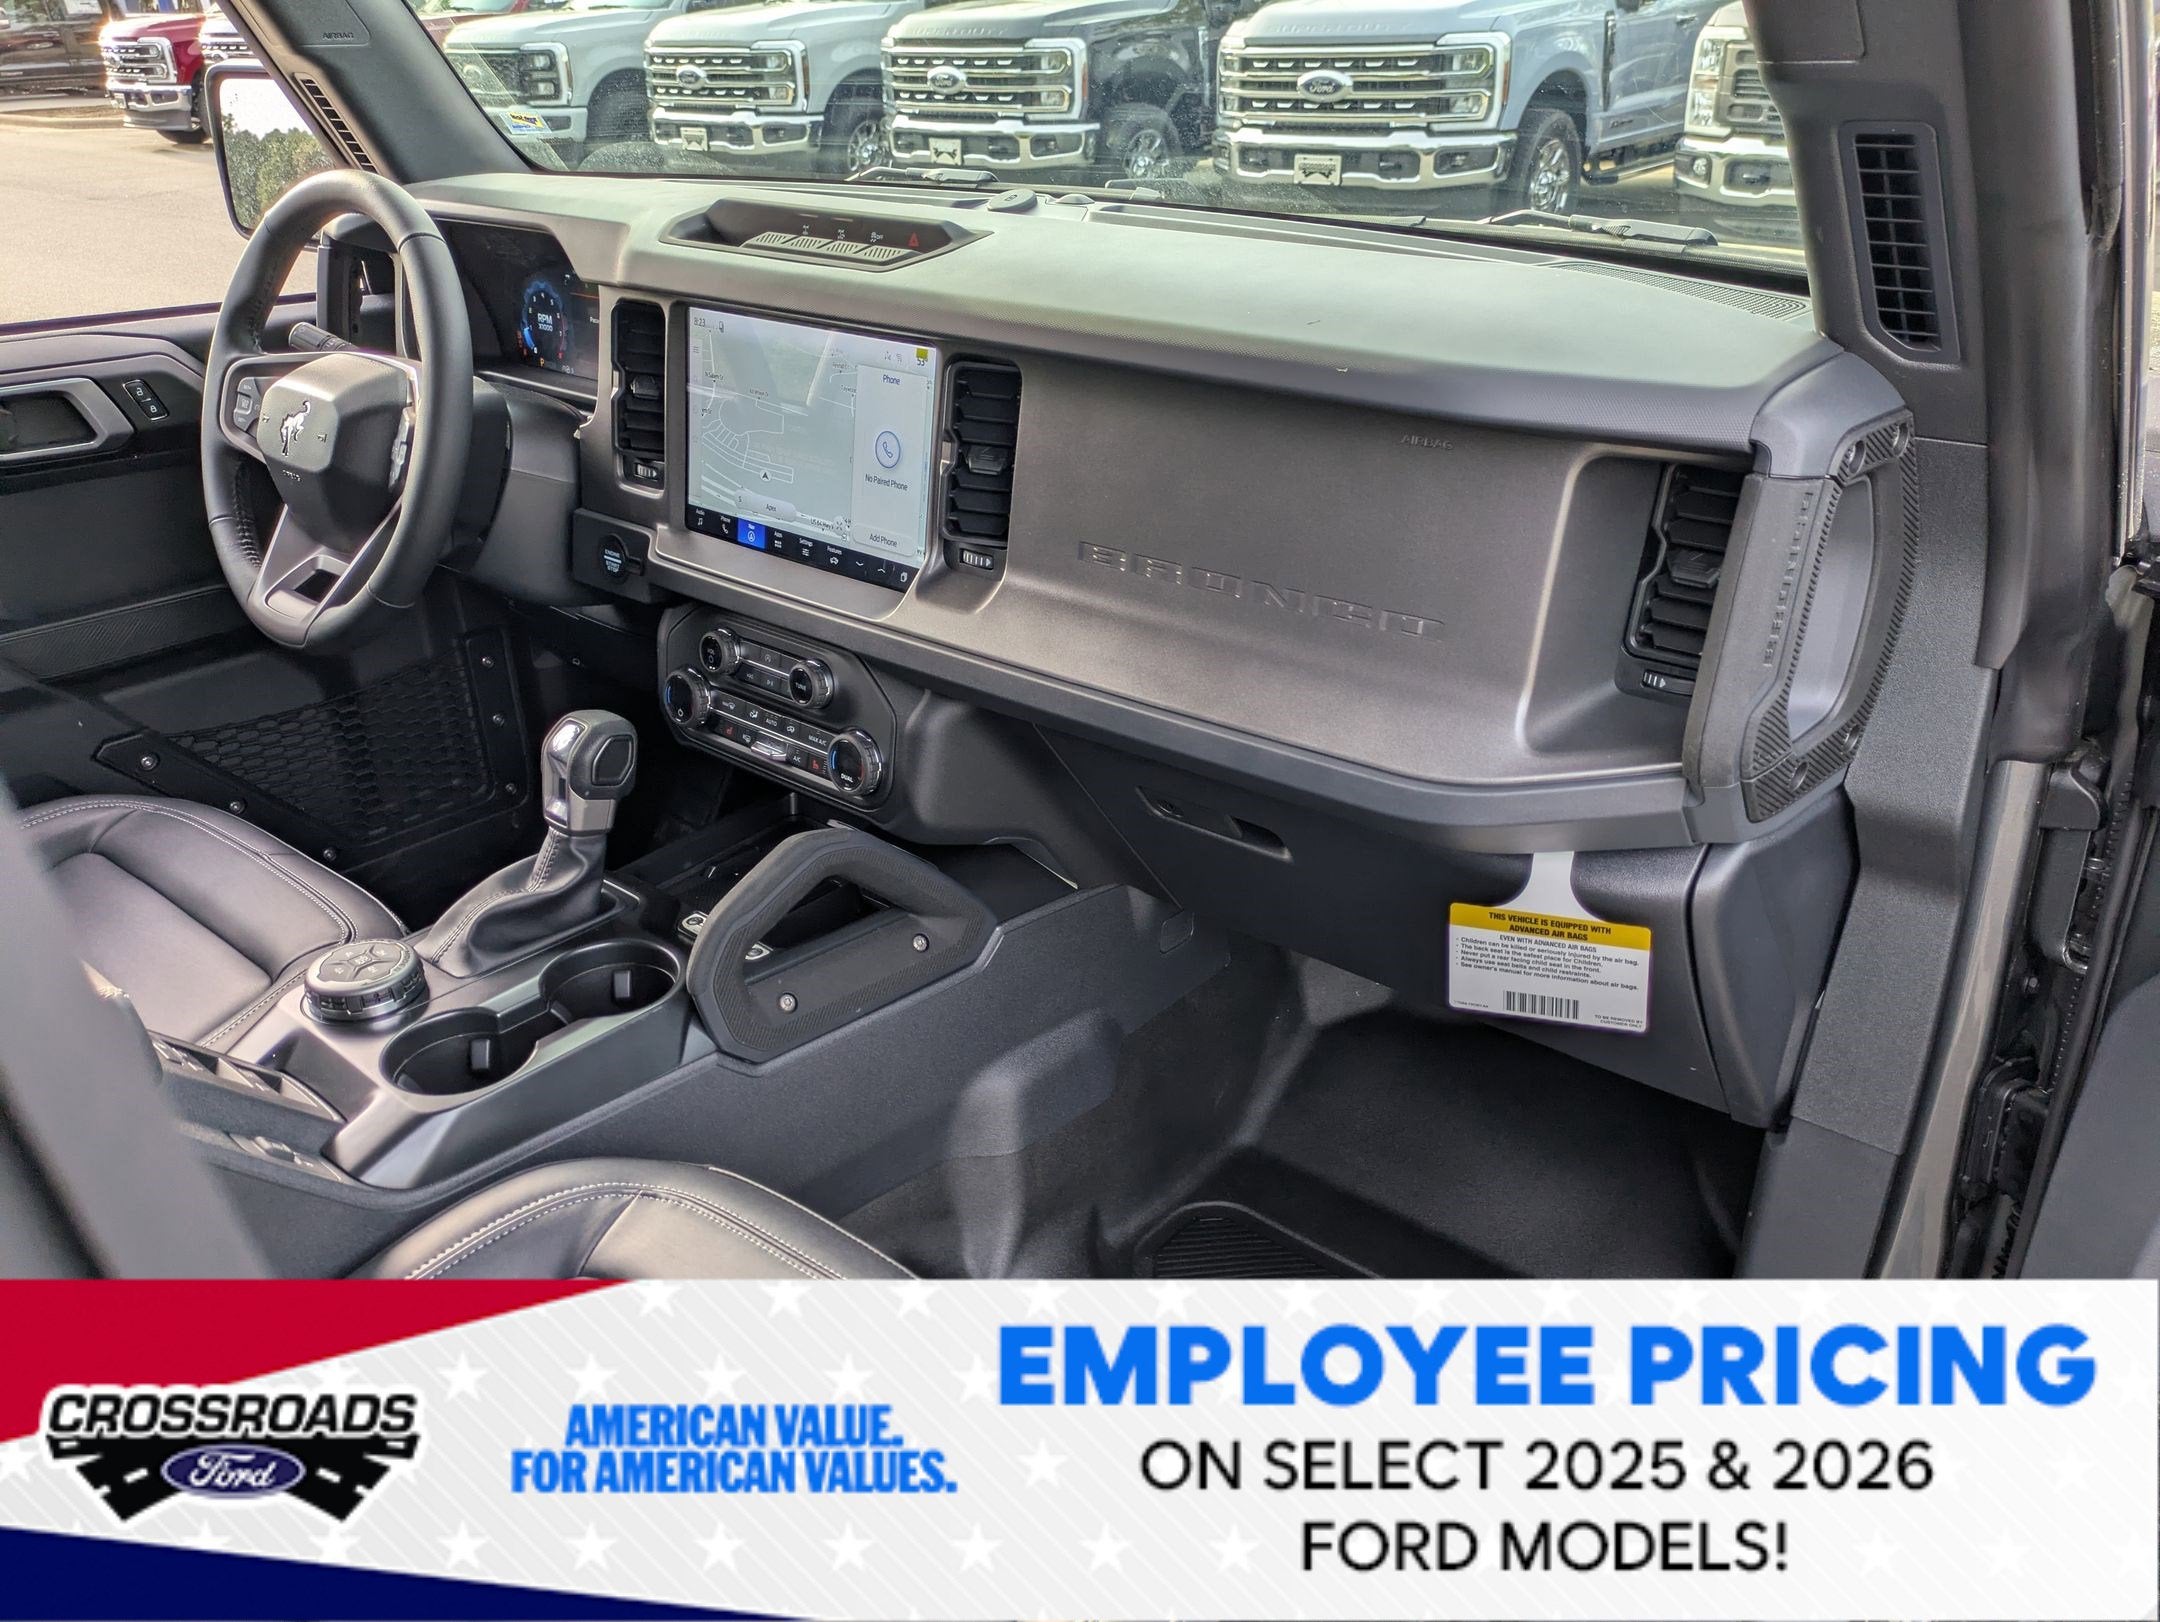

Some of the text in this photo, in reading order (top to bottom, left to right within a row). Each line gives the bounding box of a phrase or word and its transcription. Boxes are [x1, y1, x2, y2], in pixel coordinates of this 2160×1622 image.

[1309, 79, 1335, 93] Ford
[537, 313, 553, 325] RPM
[693, 317, 706, 327] 8:23
[882, 374, 901, 386] Phone
[1400, 434, 1455, 450] AIRBAG
[865, 473, 908, 491] No Paired Phone
[869, 533, 898, 548] Add Phone
[1078, 540, 1445, 643] BRONCO
[765, 718, 777, 727] AUTO
[808, 734, 827, 746] MAX A/C
[793, 755, 801, 763] A/C
[840, 773, 854, 783] DUAL
[1489, 912, 1611, 935] THIS VEHICLE IS EQUIPPED WITH
[1509, 924, 1588, 941] ADVANCED AIR BAGS
[1461, 937, 1487, 946] Children
[1537, 948, 1567, 957] seriously
[1516, 937, 1532, 945] WITH
[1533, 939, 1567, 949] ADVANCED
[1580, 945, 1597, 953] BAGS
[1461, 949, 1478, 957] Never
[1510, 956, 1530, 965] facing
[1461, 956, 1483, 964] Always
[1511, 962, 1527, 970] belts
[1473, 964, 1497, 972] owner's
[1590, 979, 1609, 987] about
